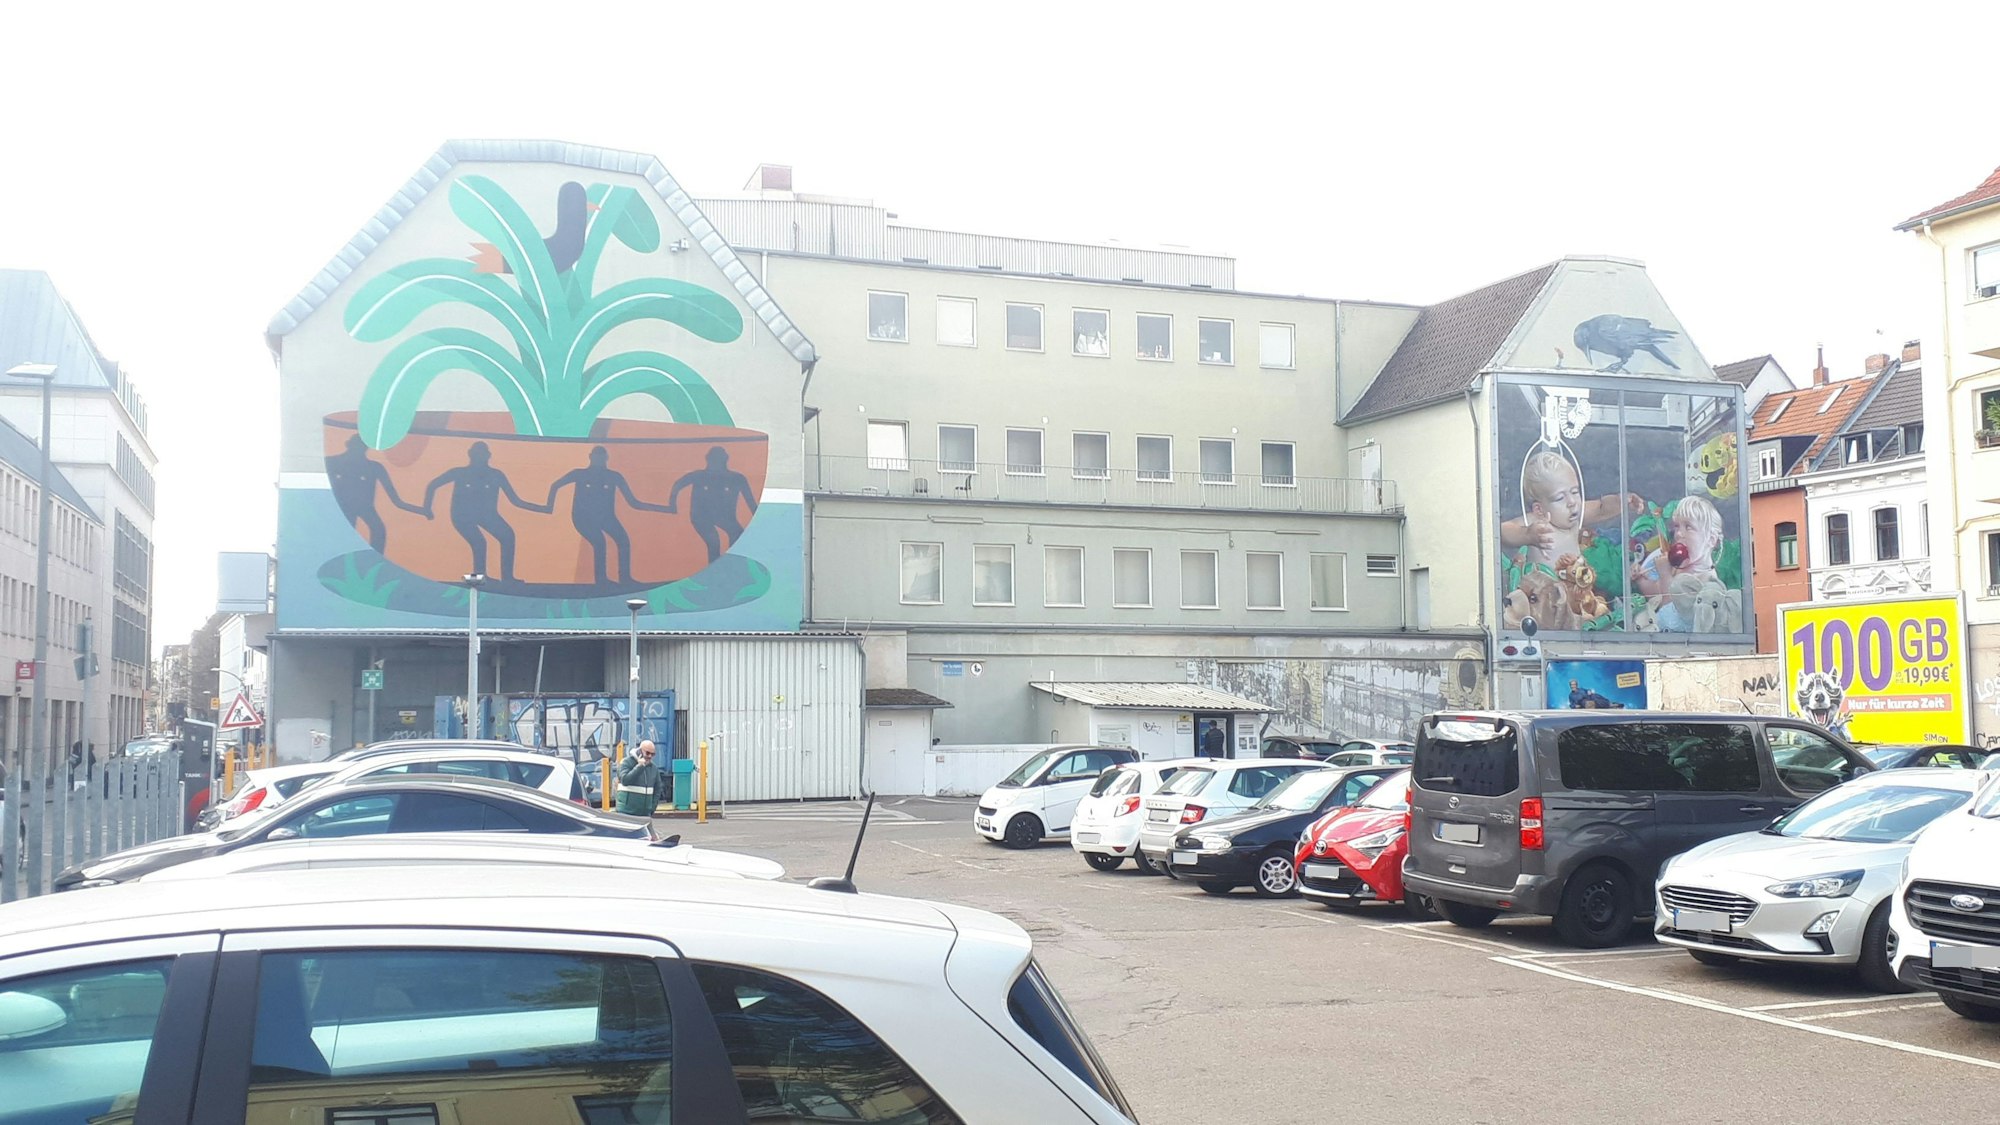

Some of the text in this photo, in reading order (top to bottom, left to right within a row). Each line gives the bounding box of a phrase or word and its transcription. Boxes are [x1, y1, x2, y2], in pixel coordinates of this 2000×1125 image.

[1793, 617, 1949, 691] 100 GB
[1848, 696, 1945, 709] Nur für kurze Zeit
